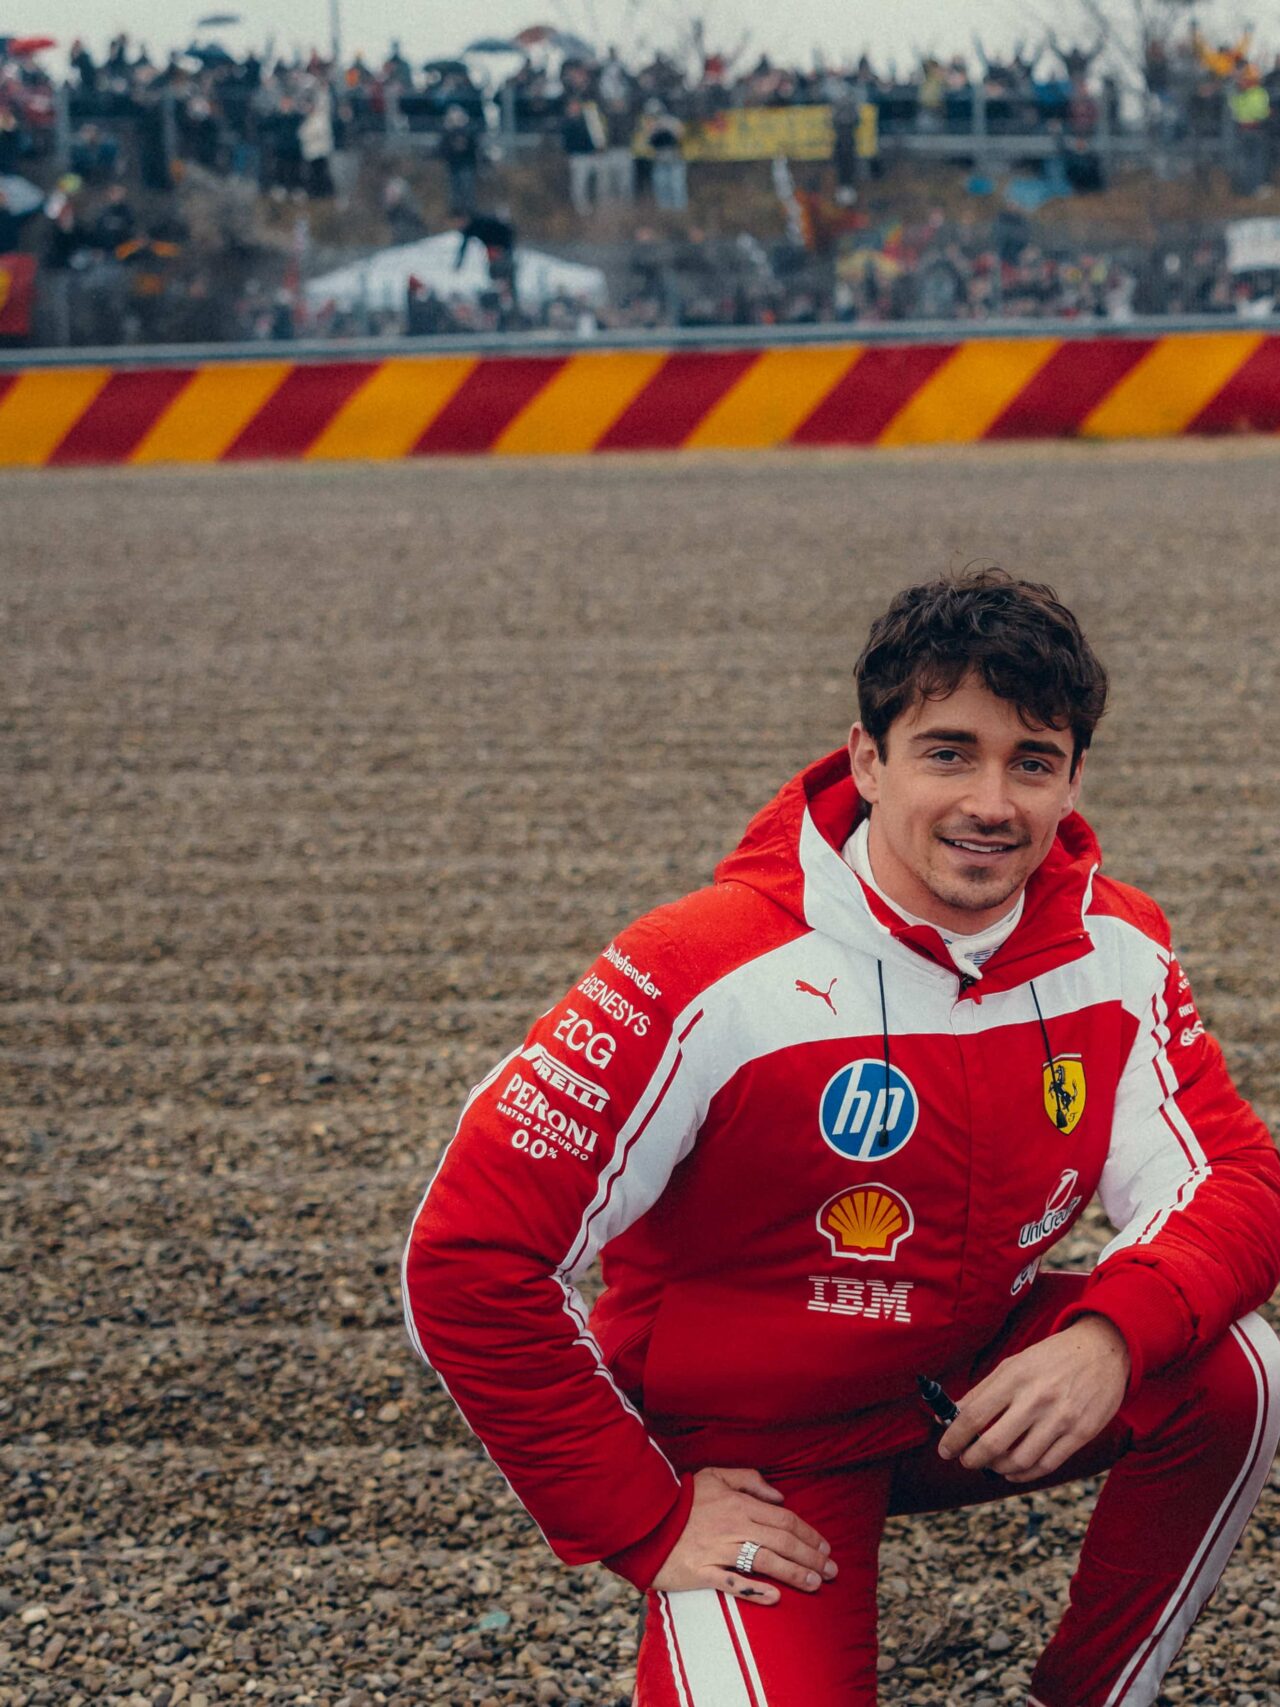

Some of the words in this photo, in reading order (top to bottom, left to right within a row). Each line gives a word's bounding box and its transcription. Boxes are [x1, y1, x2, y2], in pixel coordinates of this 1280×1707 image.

[520, 1042, 610, 1113] PIRELLI
[830, 1060, 907, 1161] hp
[496, 1101, 532, 1127] NASTRO
[533, 1123, 590, 1162] AZZURRO
[501, 1073, 599, 1153] PERONI
[511, 1129, 559, 1160] 0.0%
[807, 1275, 914, 1323] IBM
